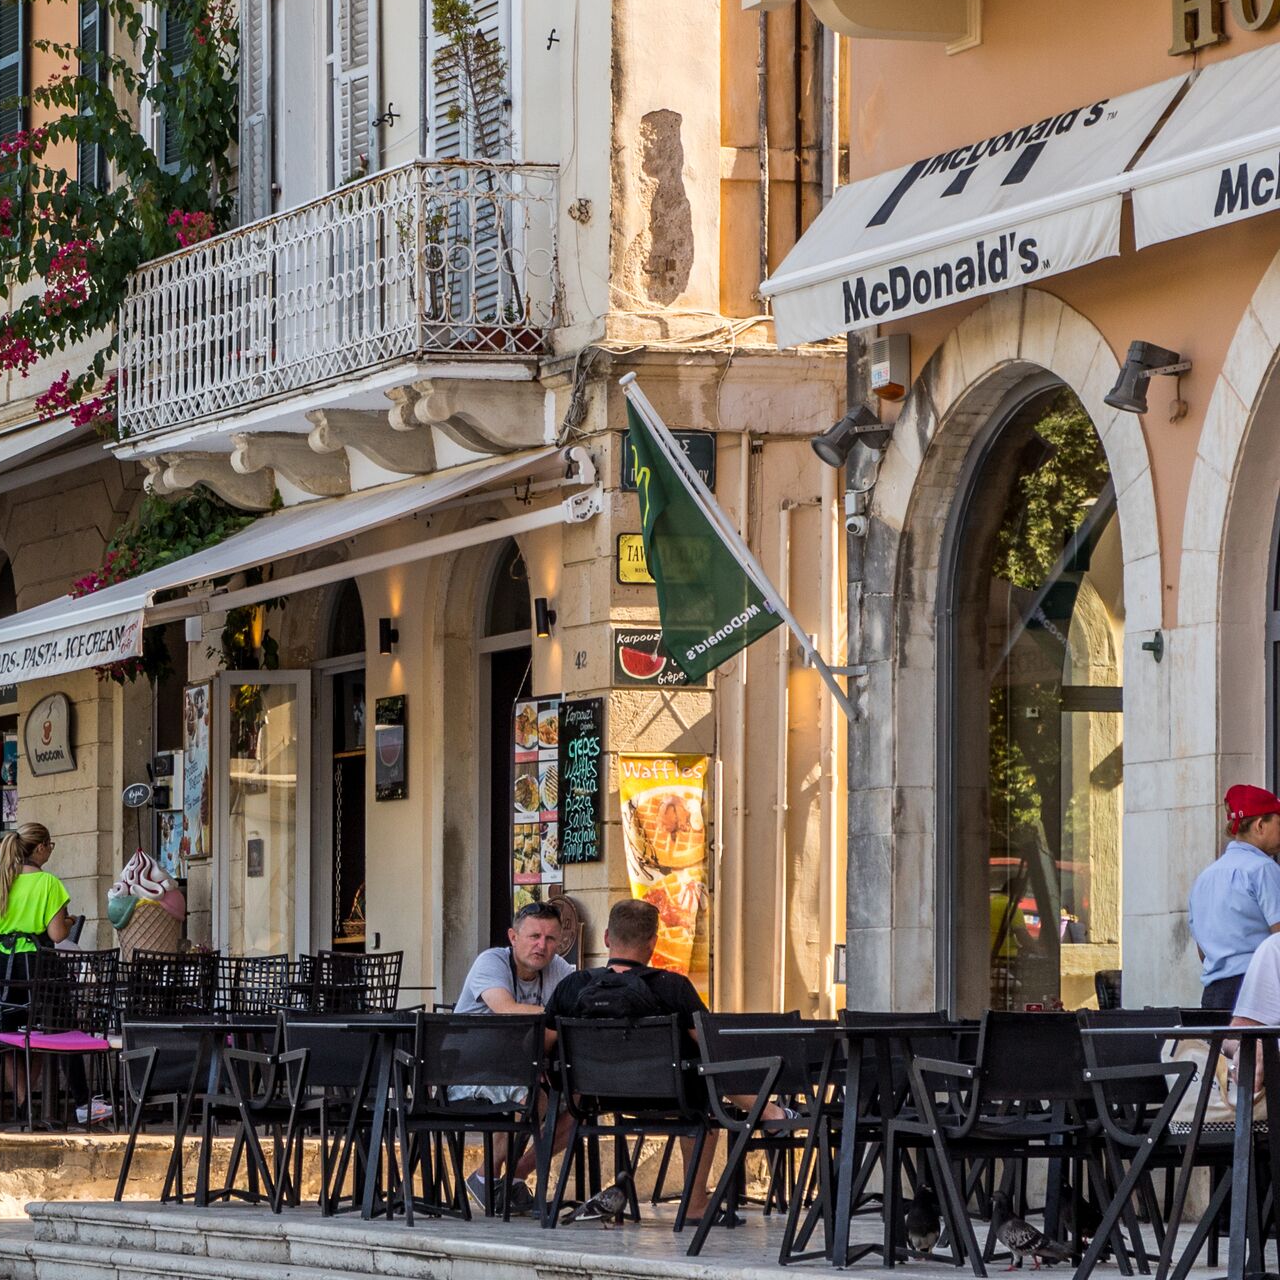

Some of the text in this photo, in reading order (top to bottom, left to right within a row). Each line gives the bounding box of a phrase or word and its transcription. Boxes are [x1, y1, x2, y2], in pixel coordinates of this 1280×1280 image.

[921, 98, 1110, 178] McDonald's
[1213, 156, 1280, 217] Mc
[843, 231, 1039, 324] McDonald's
[21, 640, 58, 670] PASTA
[65, 634, 87, 660] ICE
[86, 625, 126, 654] CREAM
[575, 650, 588, 670] 42
[34, 744, 65, 764] bocconi
[621, 759, 705, 780] Waffles
